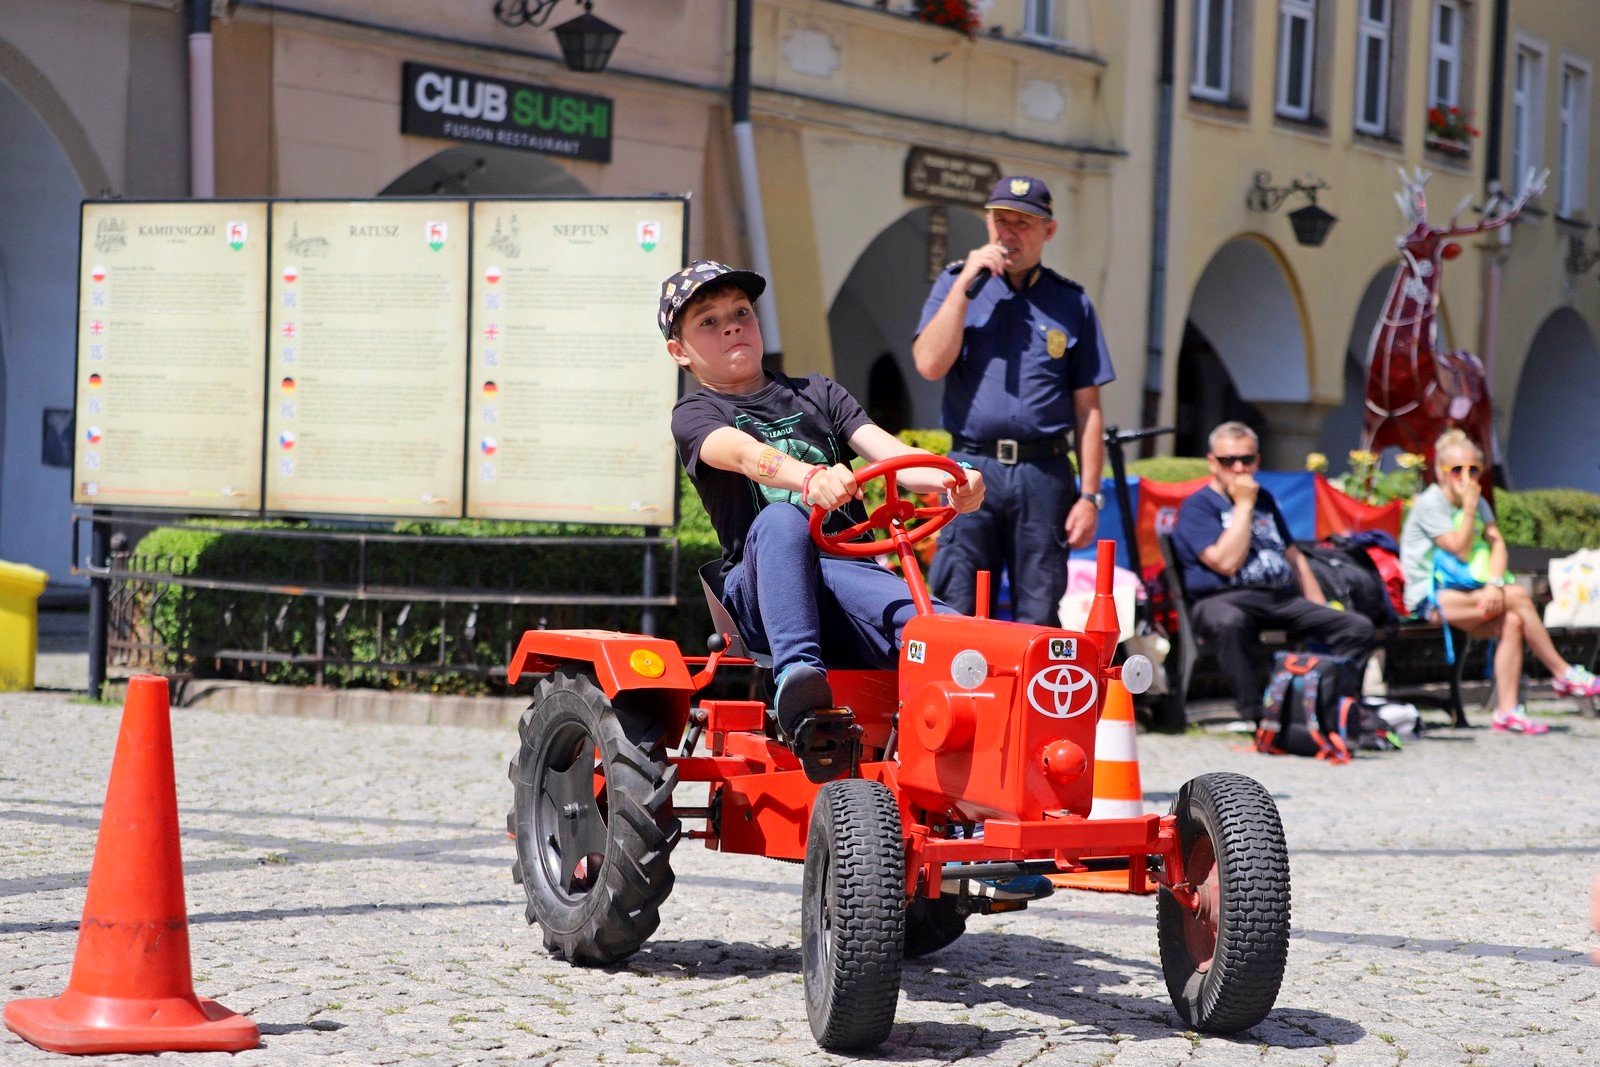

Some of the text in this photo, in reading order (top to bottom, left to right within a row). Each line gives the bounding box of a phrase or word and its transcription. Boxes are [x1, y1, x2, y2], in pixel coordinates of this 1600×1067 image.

[415, 72, 608, 138] CLUB SUSHI
[443, 122, 581, 154] FUSION RESTAURANT
[138, 225, 216, 237] KAMIENICZKI
[348, 225, 400, 237] RATUSZ
[553, 225, 610, 237] NEPTUN
